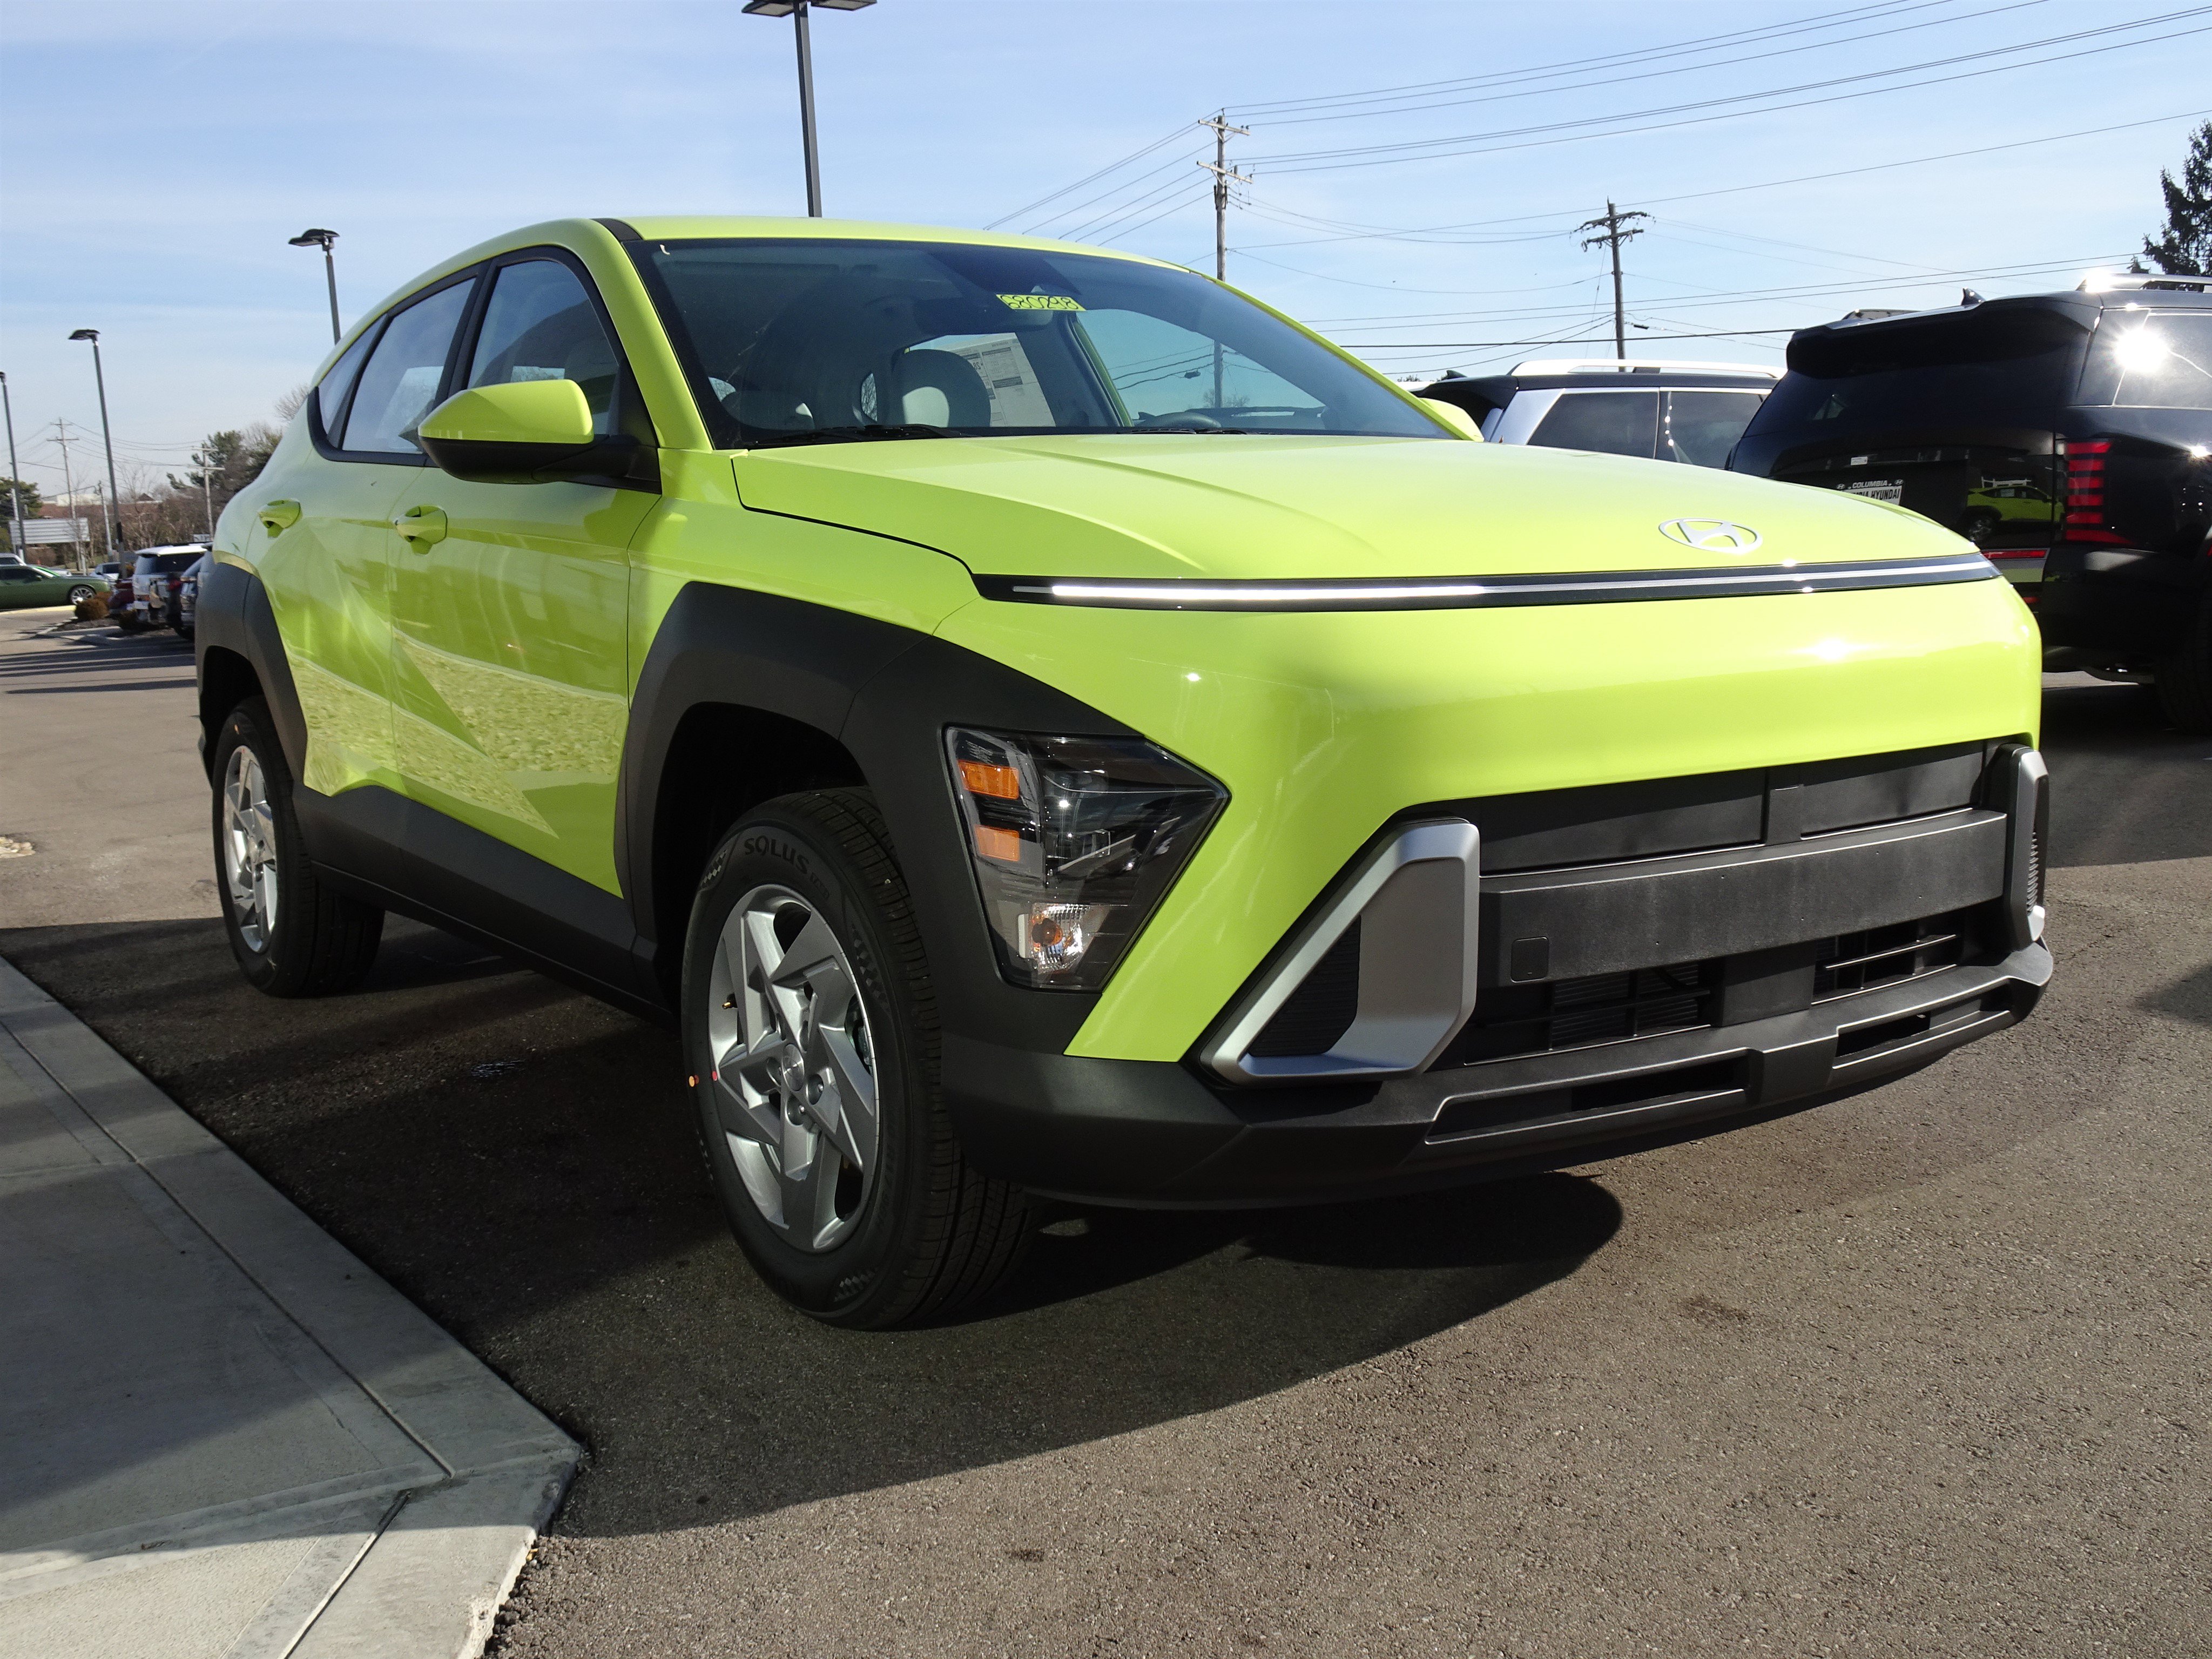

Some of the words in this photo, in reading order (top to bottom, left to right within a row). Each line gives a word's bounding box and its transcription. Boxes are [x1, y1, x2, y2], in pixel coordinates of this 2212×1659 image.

[1852, 480, 1888, 489] COLUMBIA
[1871, 488, 1900, 500] HYUNDAI
[744, 835, 810, 874] SOLUS
